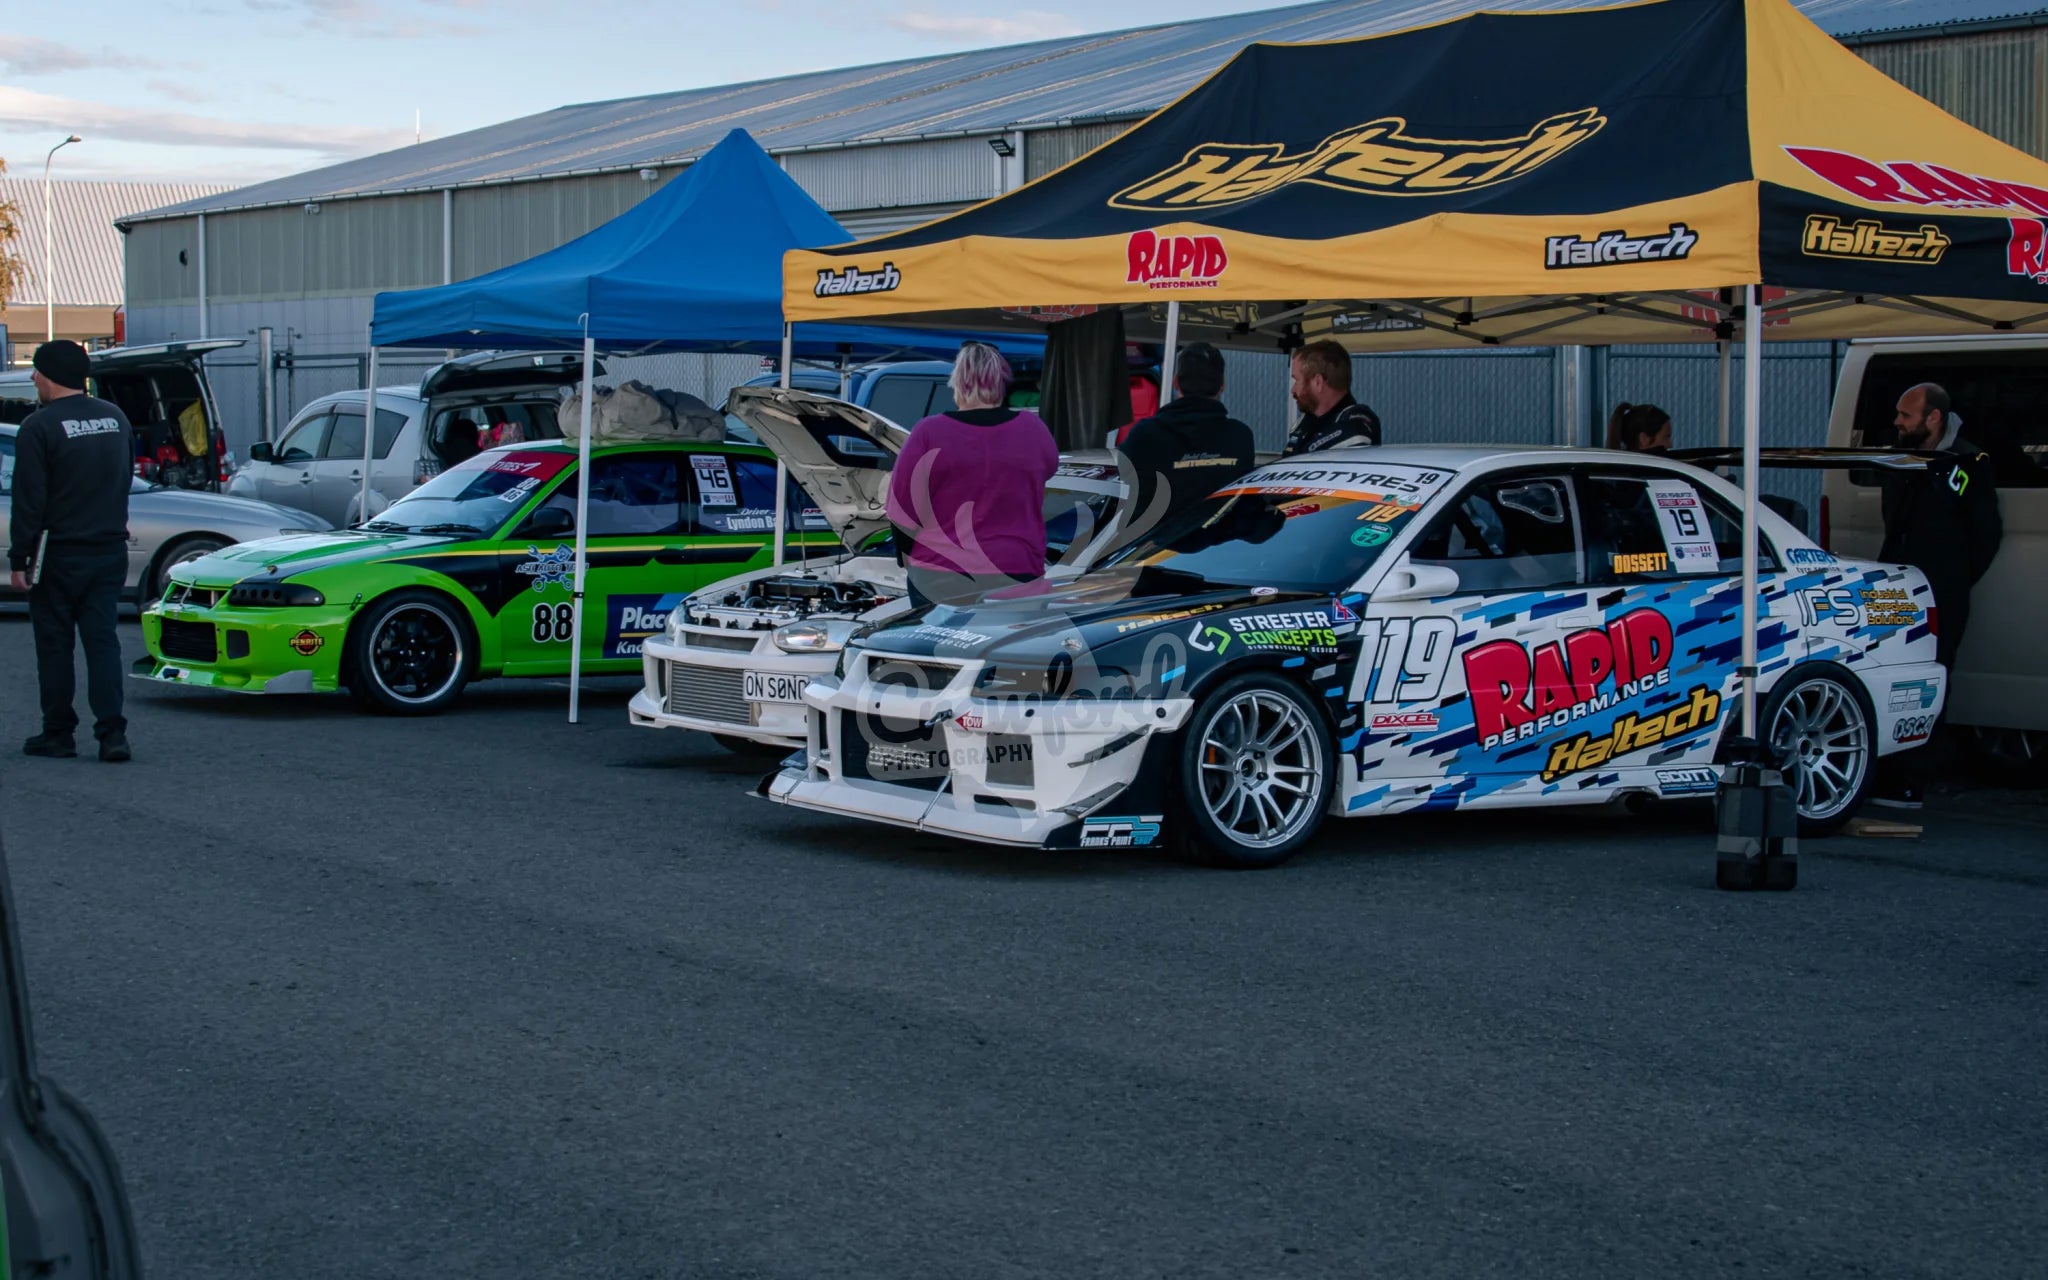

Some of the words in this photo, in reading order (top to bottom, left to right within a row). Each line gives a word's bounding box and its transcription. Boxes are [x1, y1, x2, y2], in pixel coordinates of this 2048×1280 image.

[1124, 117, 1593, 205] Haltech
[1547, 226, 1696, 266] Haltech
[1804, 219, 1949, 260] Haltech
[1126, 228, 1228, 284] RAPID
[815, 264, 900, 295] Haltech
[1149, 280, 1218, 289] PERFORMANCE
[61, 417, 119, 435] RAPID
[699, 469, 729, 489] 46
[1325, 471, 1420, 492] TYRES
[1414, 472, 1440, 485] 19
[740, 508, 769, 516] Driver
[1356, 504, 1408, 522] 119
[1668, 508, 1699, 536] 19
[727, 516, 764, 530] Lyndon
[1613, 552, 1668, 574] DOSSETT
[1860, 589, 1908, 599] Industrial
[1794, 588, 1860, 627] IFS
[1864, 602, 1918, 612] Fibreglass
[532, 602, 574, 642] 88
[620, 606, 668, 630] Plac
[1117, 604, 1223, 633] Haltech
[1228, 611, 1331, 632] STREETER
[1868, 615, 1915, 625] Solutions
[290, 638, 323, 646] PENRITE
[914, 625, 993, 645] Canterbury
[1239, 629, 1337, 646] CONCEPTS
[1346, 615, 1458, 704] 119
[746, 675, 763, 697] ON
[1463, 609, 1674, 746] RAPID
[1373, 714, 1438, 724] DIXCEL
[1483, 668, 1670, 752] PERFORMANCE
[962, 715, 982, 728] TOW
[1547, 688, 1718, 780] Haltech
[1656, 769, 1710, 783] SCOTT
[1080, 836, 1109, 847] FRANKS
[1111, 836, 1132, 846] PAINT
